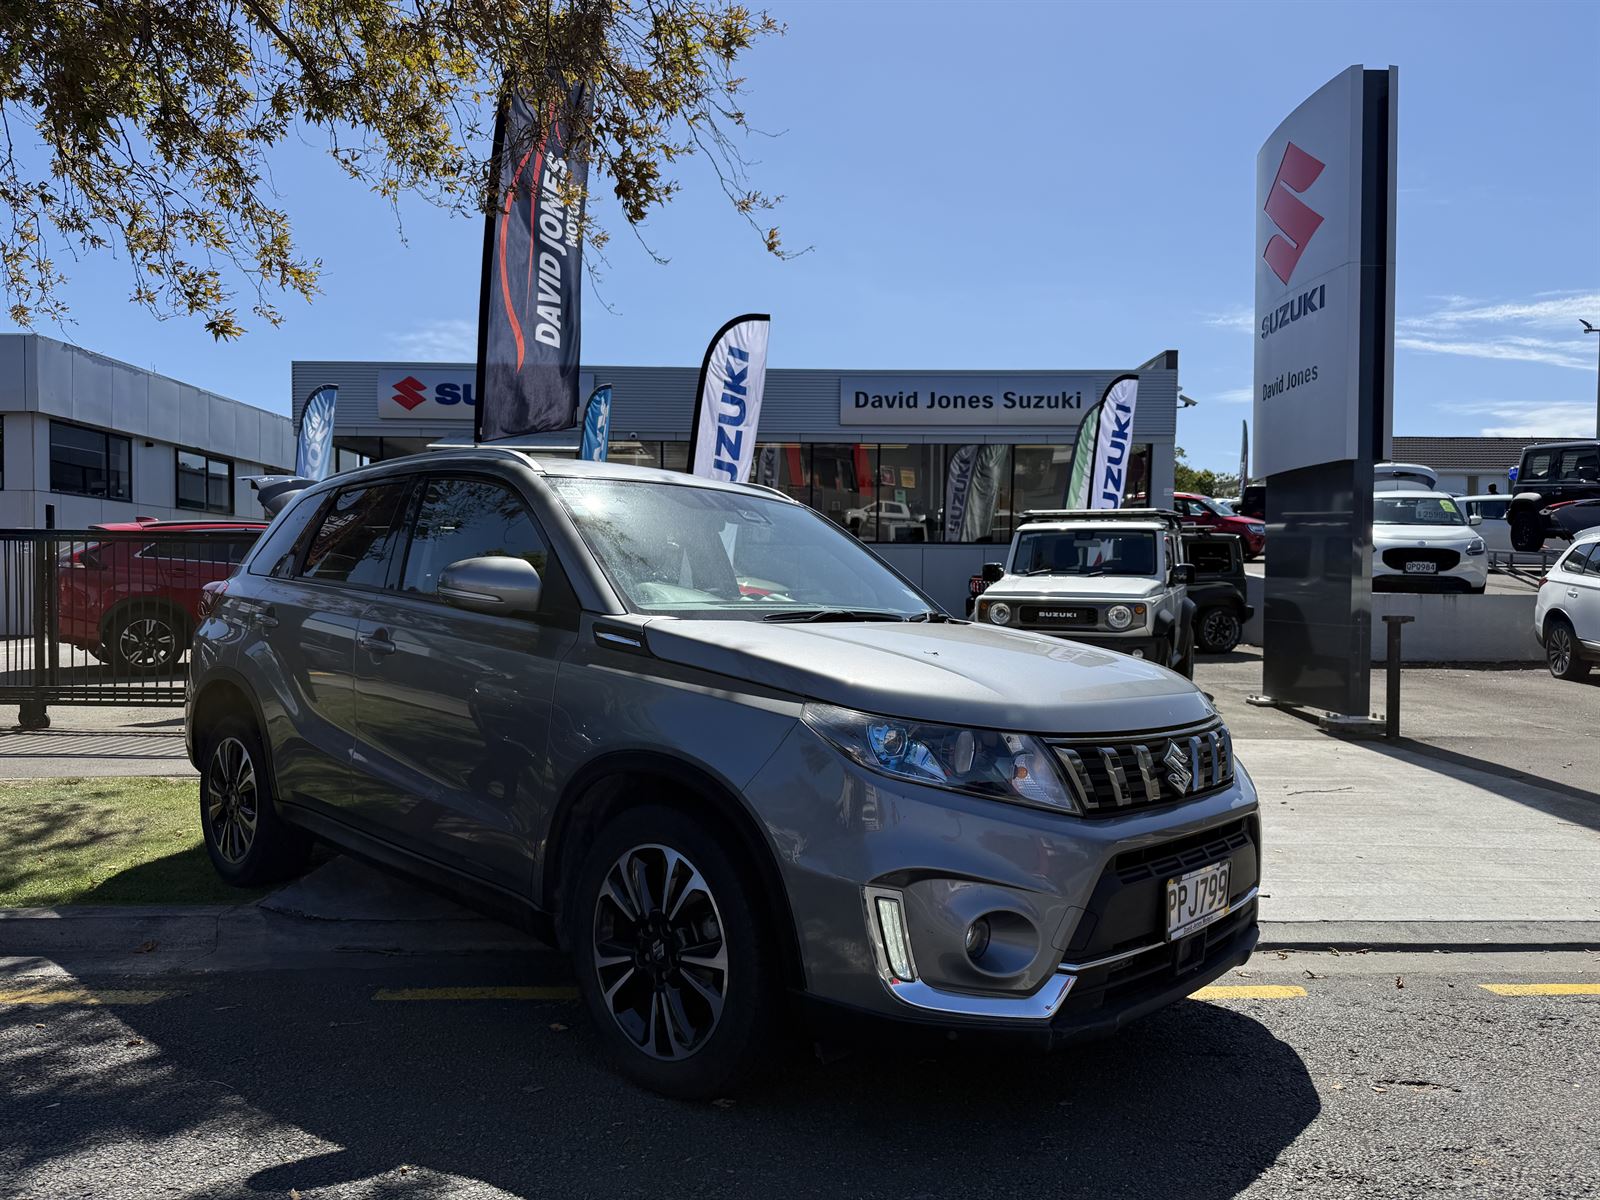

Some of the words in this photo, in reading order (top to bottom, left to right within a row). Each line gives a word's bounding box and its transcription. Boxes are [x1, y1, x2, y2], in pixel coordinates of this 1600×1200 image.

[540, 151, 568, 256] JONES
[535, 252, 561, 348] DAVID
[1261, 284, 1326, 339] SUZUKI
[714, 345, 749, 482] UZUKI
[854, 391, 918, 409] David
[926, 391, 994, 409] Jones
[1003, 391, 1081, 409] Suzuki
[1262, 374, 1284, 401] David
[1286, 365, 1318, 390] Jones
[1101, 403, 1131, 509] UZUKI
[1167, 870, 1228, 928] PPJ799
